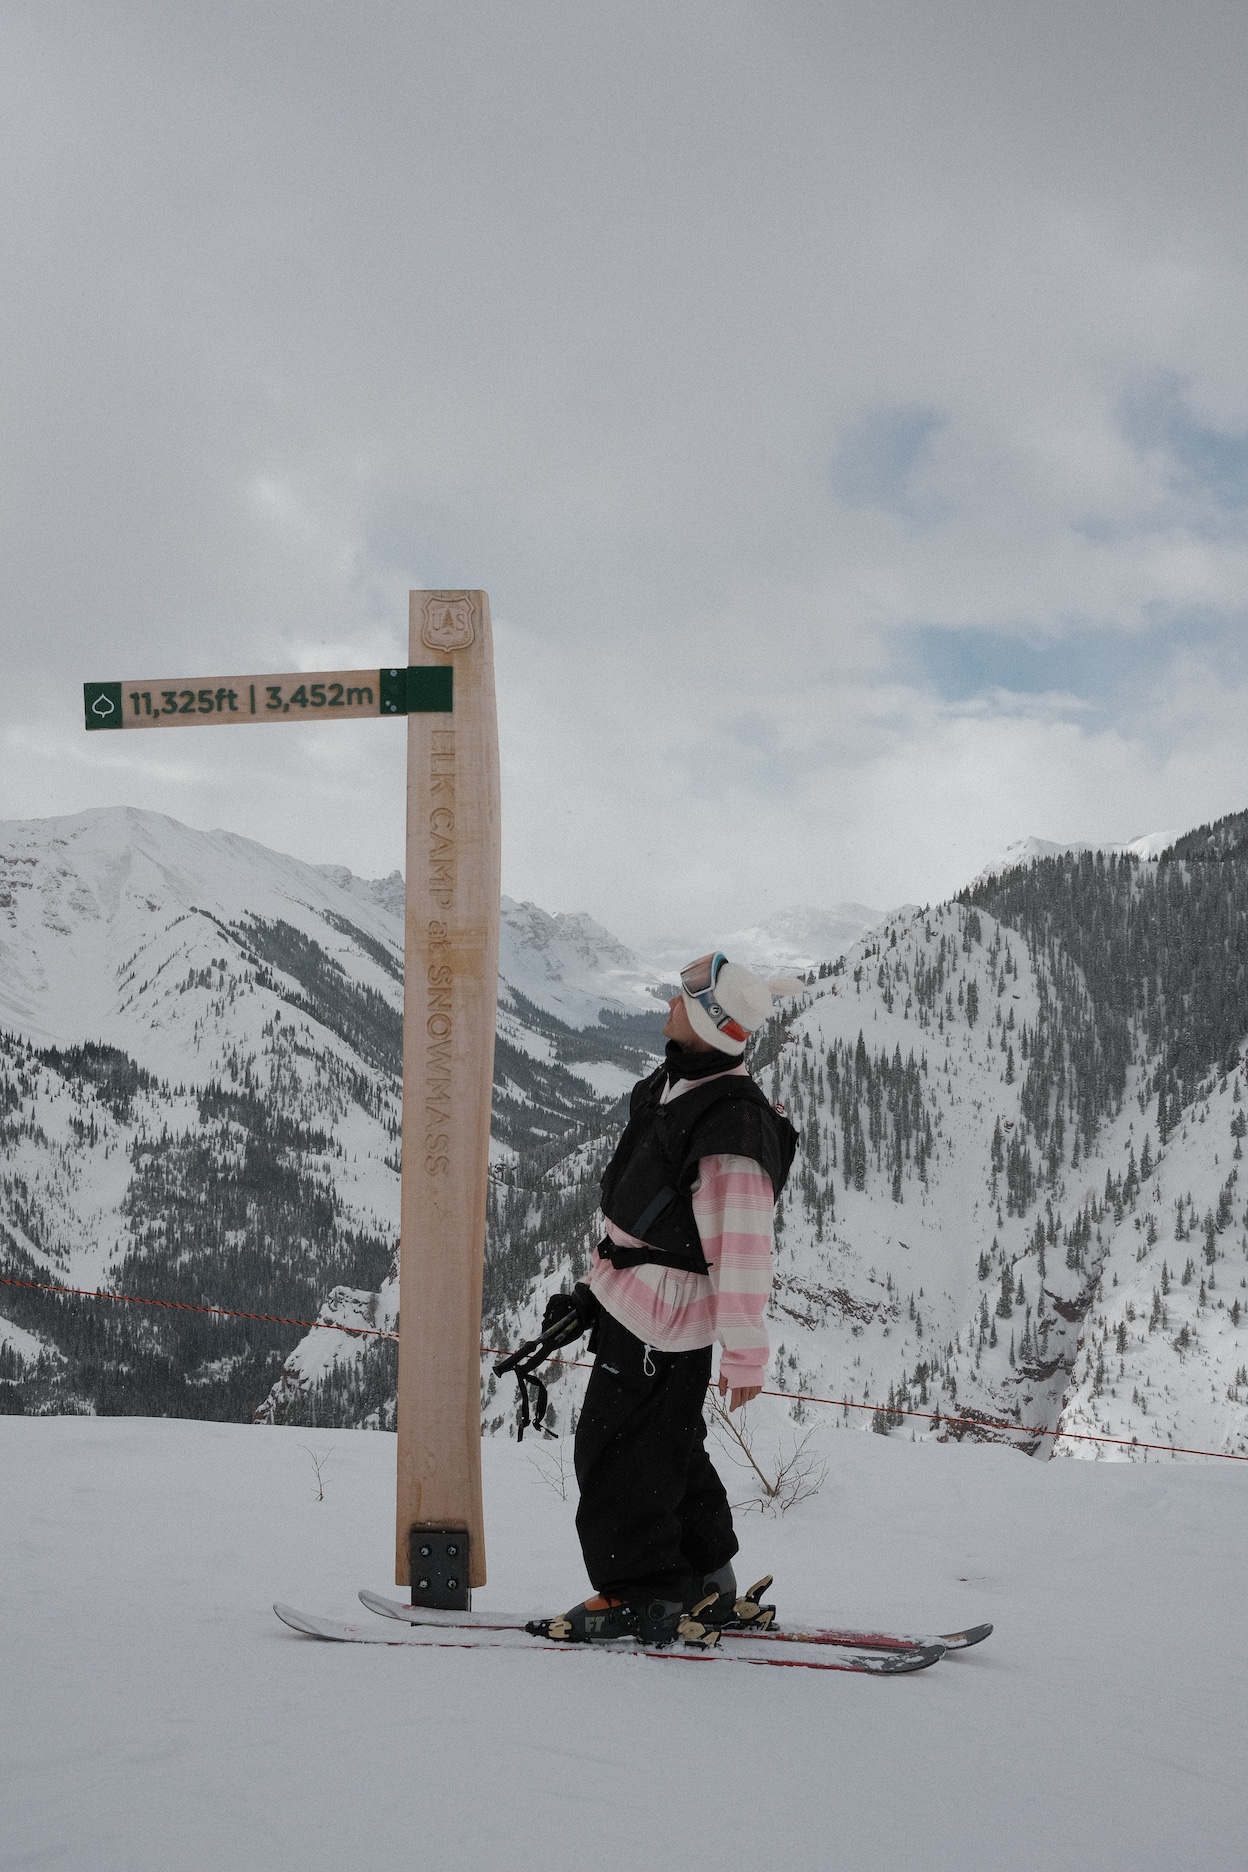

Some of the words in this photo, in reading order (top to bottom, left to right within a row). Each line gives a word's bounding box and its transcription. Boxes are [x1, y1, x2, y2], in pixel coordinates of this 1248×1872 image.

[129, 688, 238, 718] 11,325ft
[266, 683, 373, 713] 3,452m
[430, 730, 456, 797] ELK
[428, 807, 455, 910] CAMP
[428, 920, 452, 954] at
[425, 964, 453, 1177] SNOWMASS
[584, 1616, 605, 1633] FT
